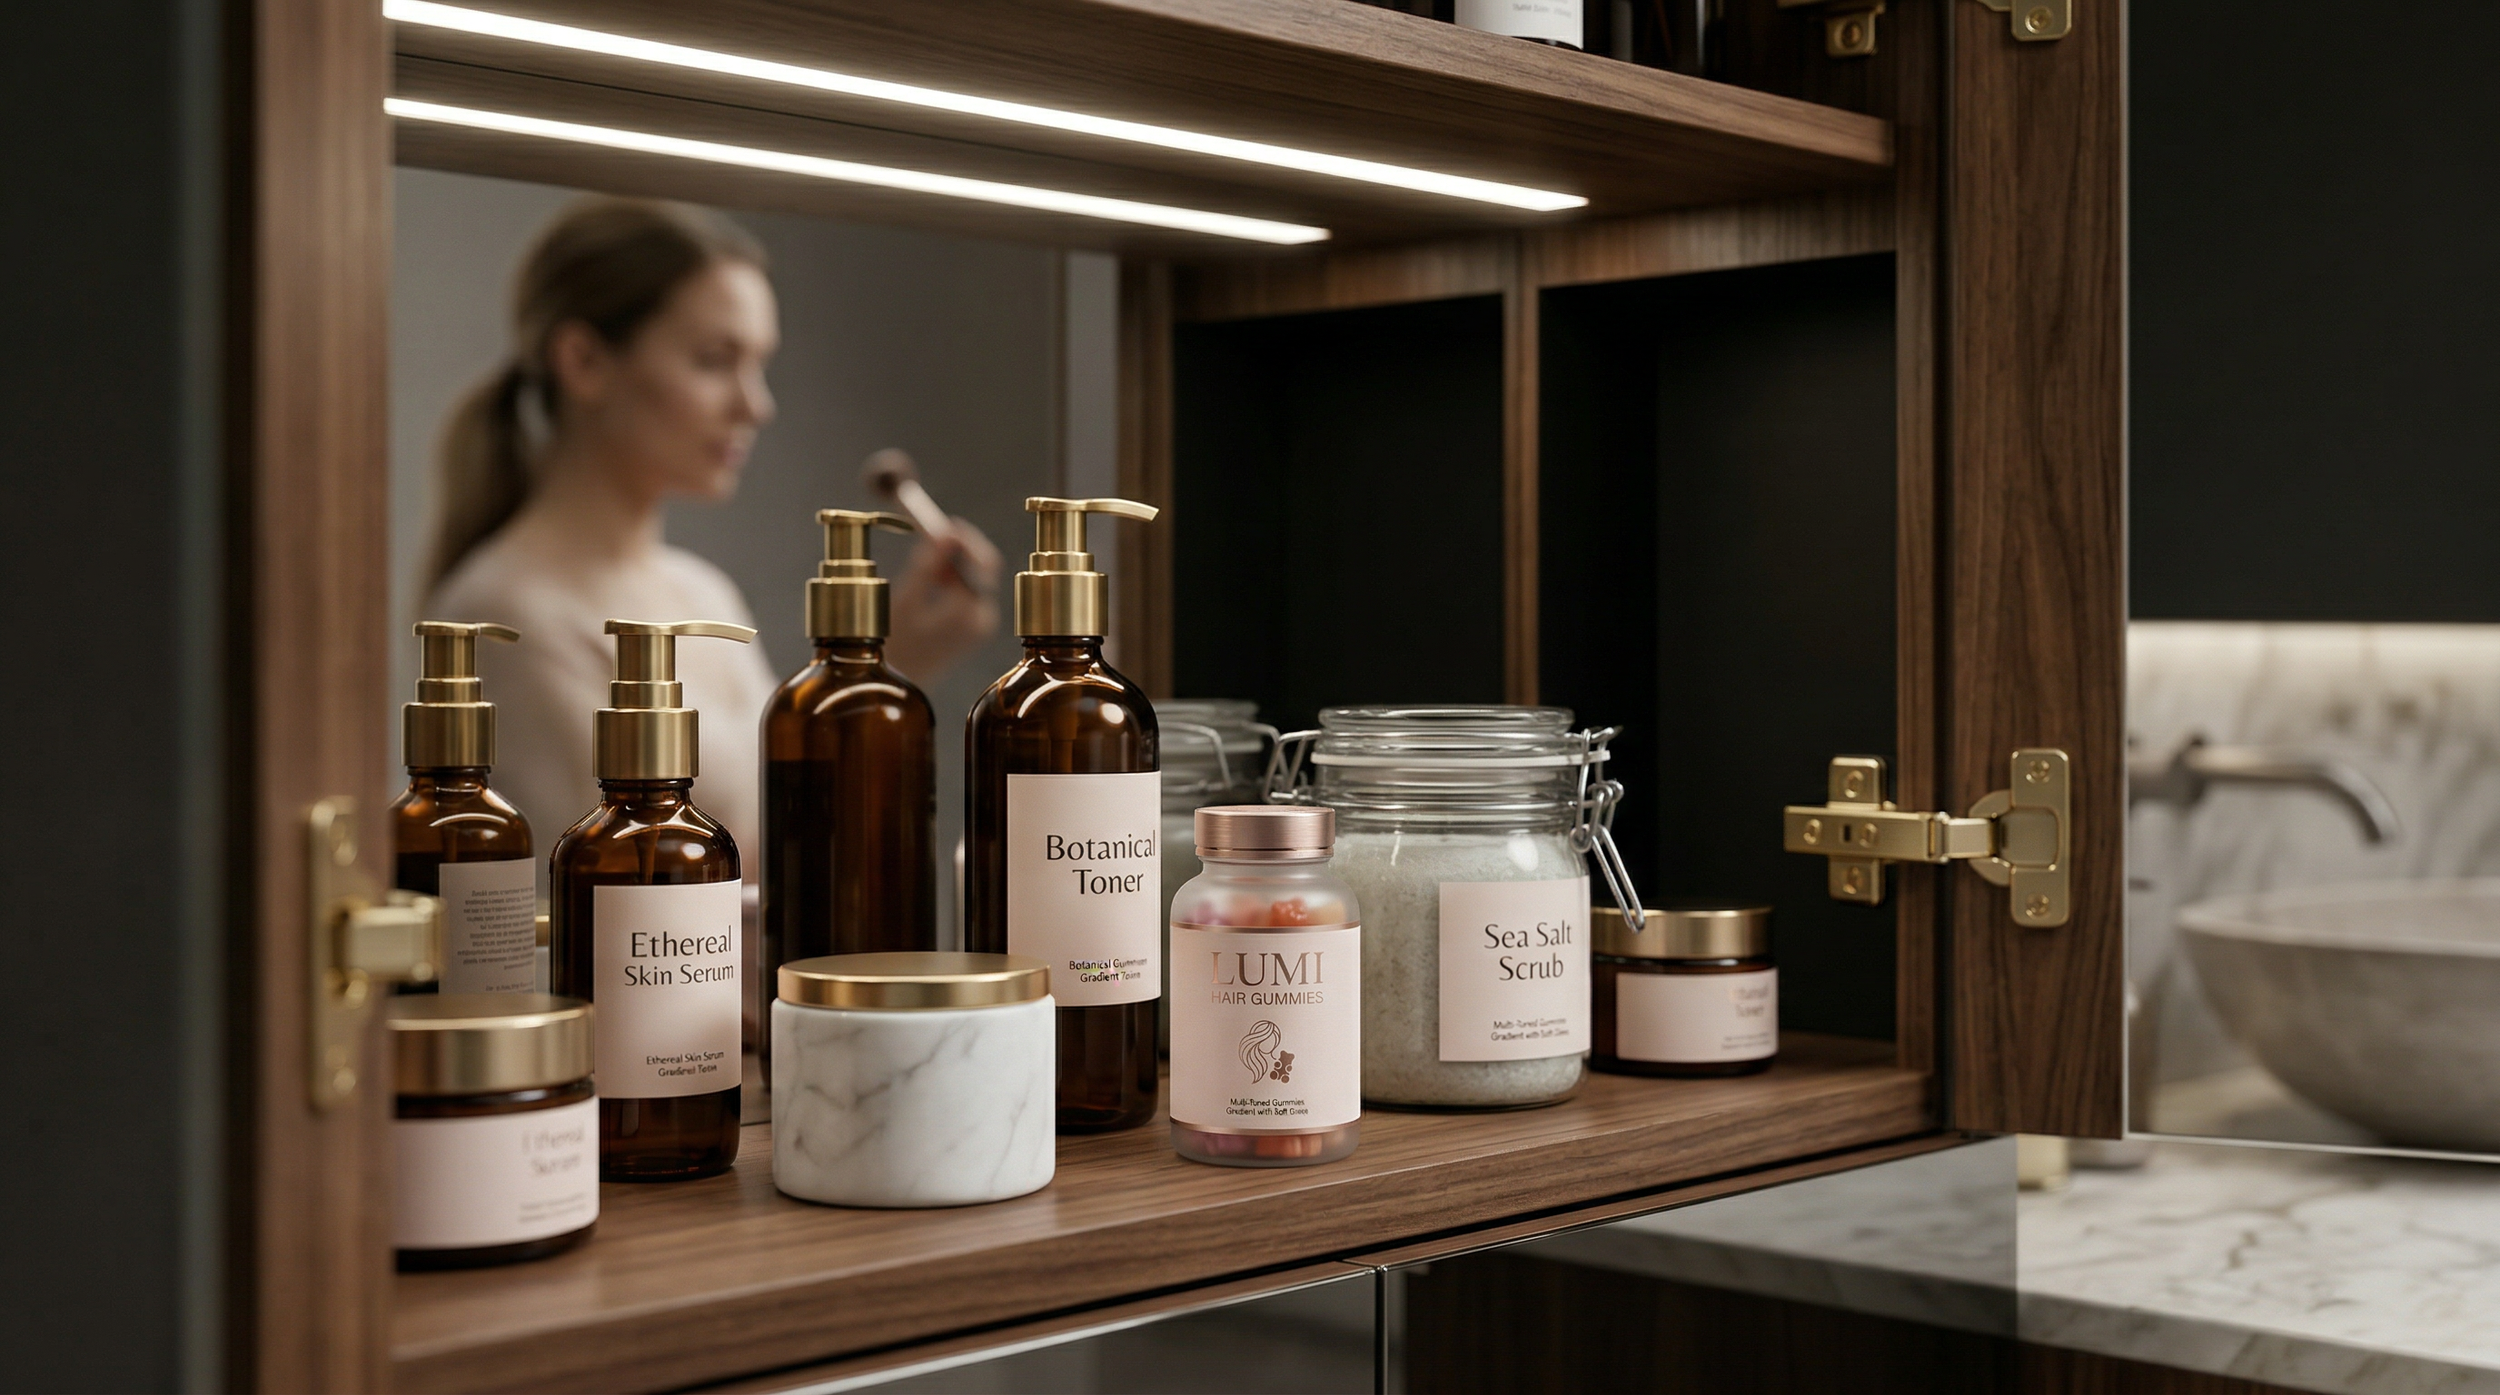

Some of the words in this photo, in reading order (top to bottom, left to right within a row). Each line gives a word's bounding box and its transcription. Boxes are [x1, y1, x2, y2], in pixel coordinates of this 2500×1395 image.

[1047, 829, 1156, 861] Botanical
[1072, 869, 1144, 895] Toner
[631, 925, 732, 958] Ethereal
[1484, 923, 1529, 949] Sea
[1536, 919, 1572, 947] Salt
[624, 965, 672, 986] Skin
[680, 964, 734, 984] Serum
[1211, 951, 1325, 987] LUMI
[1499, 952, 1564, 981] Scrub
[1211, 991, 1246, 1005] HAIR
[1251, 991, 1324, 1006] GUMMIES
[646, 1053, 683, 1065] Ethereal
[1257, 1107, 1273, 1115] with
[1272, 1098, 1305, 1106] Gummies
